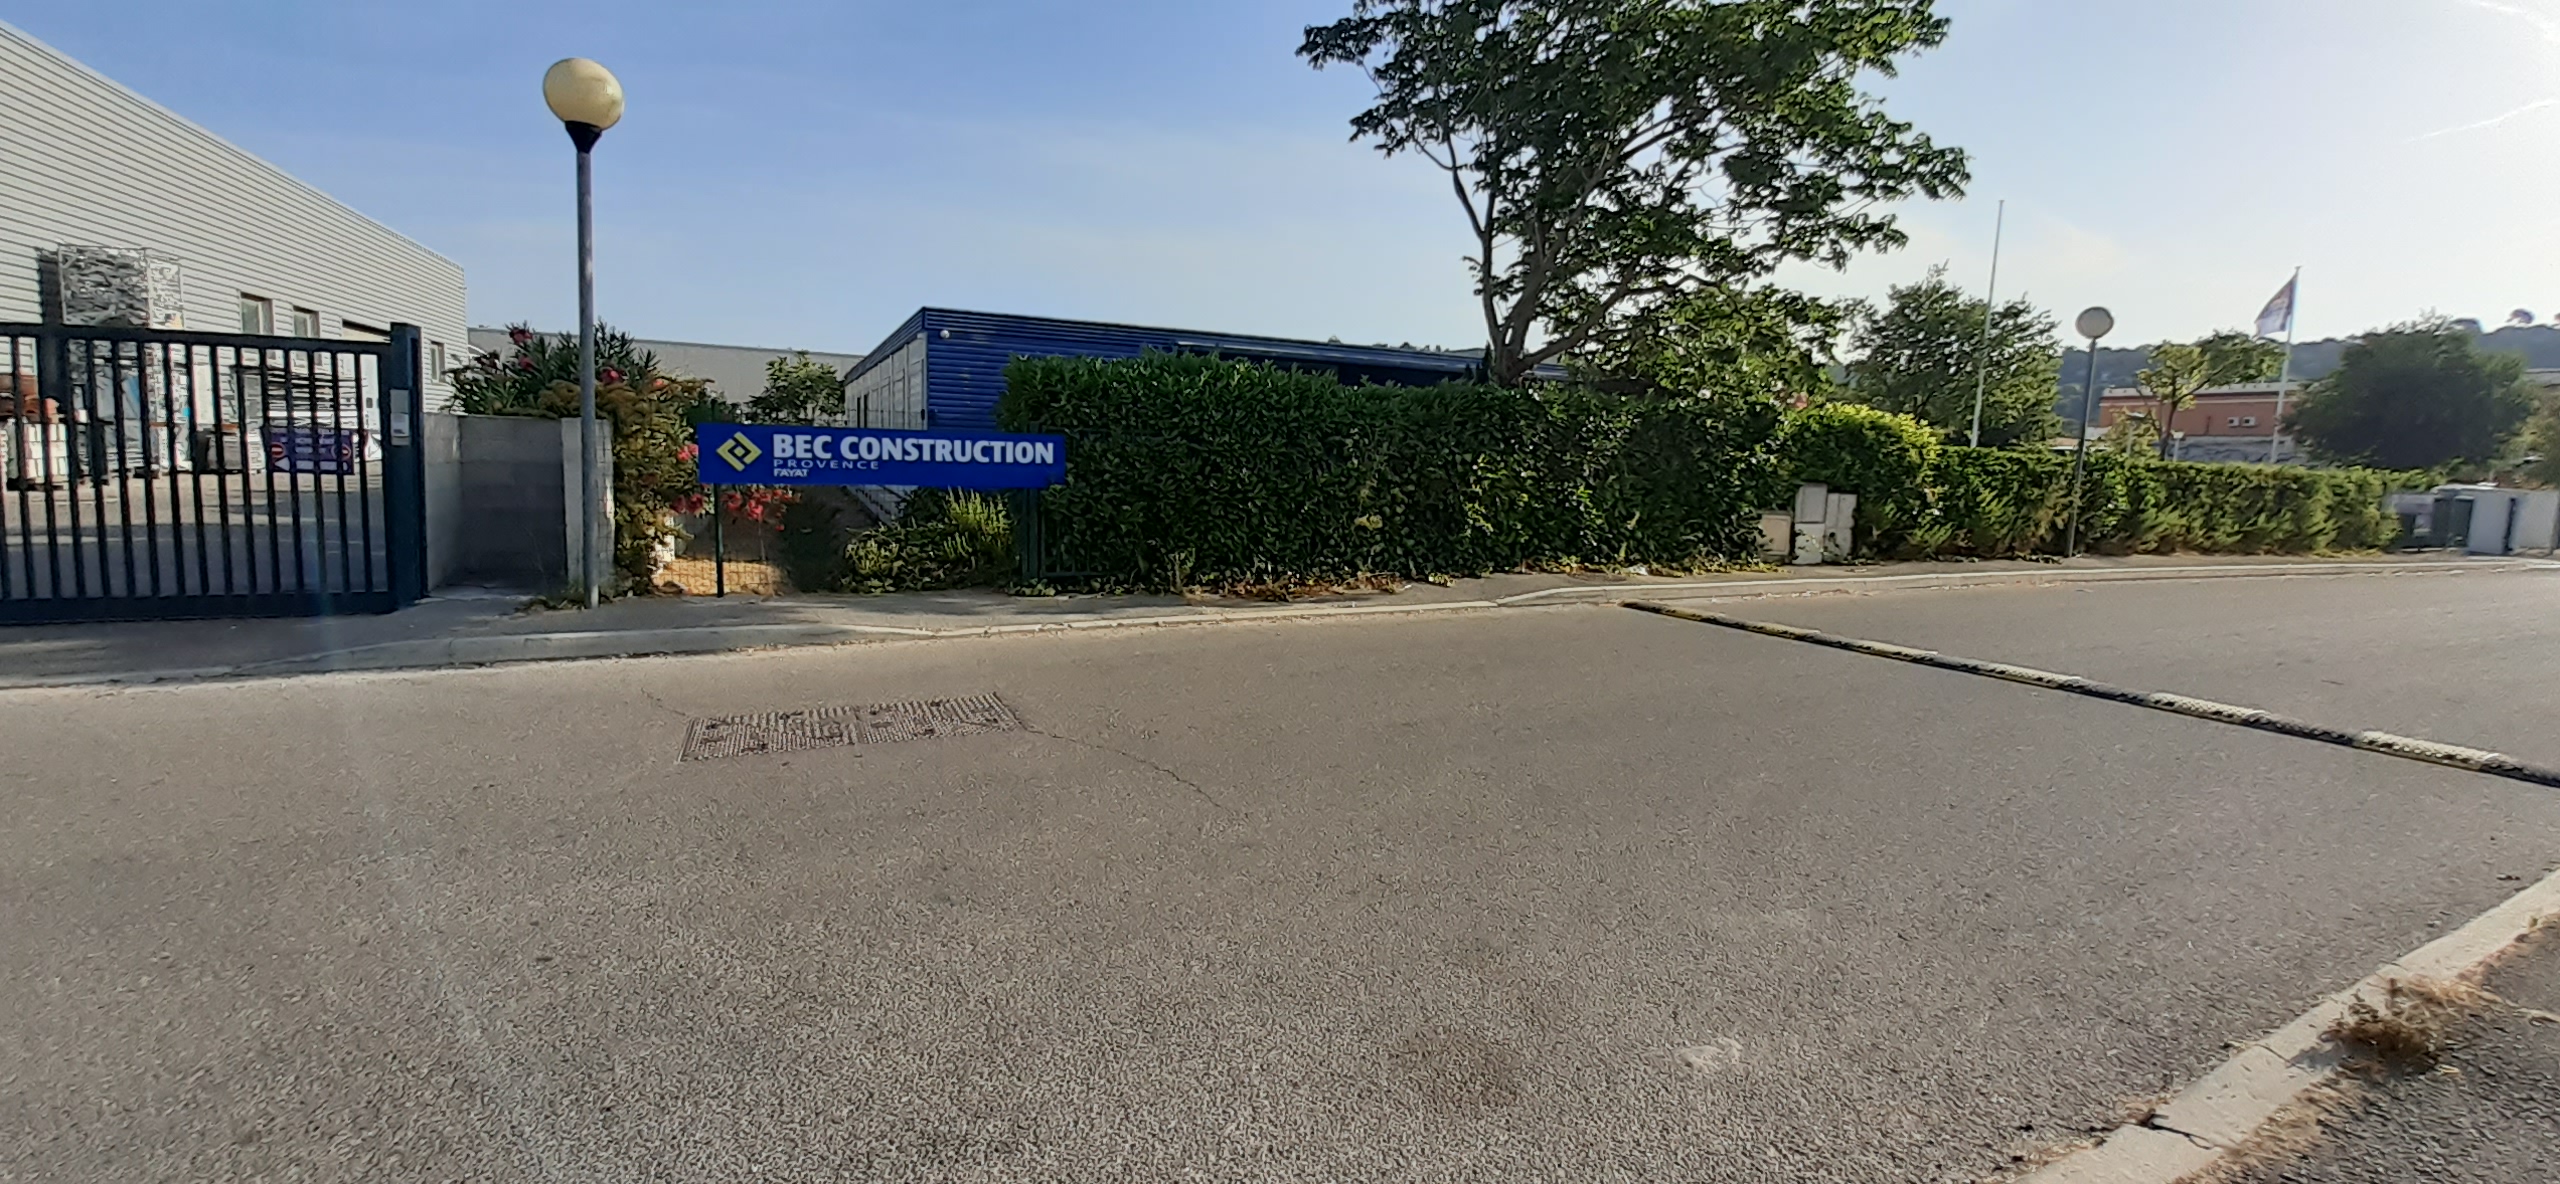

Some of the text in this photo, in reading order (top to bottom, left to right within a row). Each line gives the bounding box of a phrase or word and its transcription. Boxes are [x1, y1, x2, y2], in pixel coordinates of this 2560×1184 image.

[773, 433, 1054, 464] BEC CONSTRUCTION
[773, 459, 879, 470] PROVENCE
[773, 468, 808, 477] FAYAT
